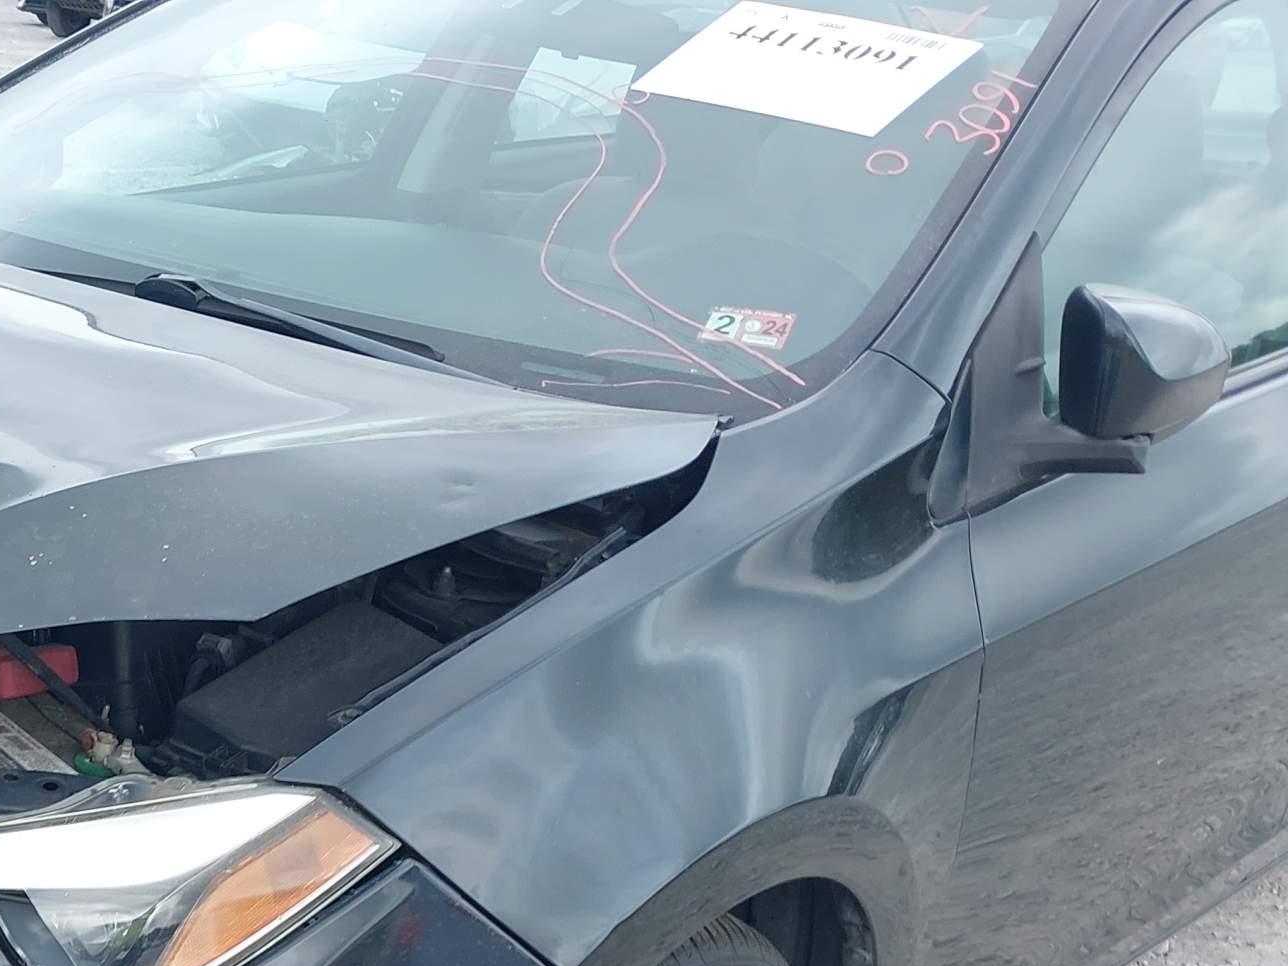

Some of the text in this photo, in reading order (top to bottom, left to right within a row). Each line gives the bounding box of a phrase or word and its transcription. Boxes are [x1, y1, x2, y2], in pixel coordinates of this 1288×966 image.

[728, 25, 918, 71] 44113091
[924, 69, 1039, 156] 3091
[714, 314, 736, 335] 2
[762, 320, 790, 337] 24
